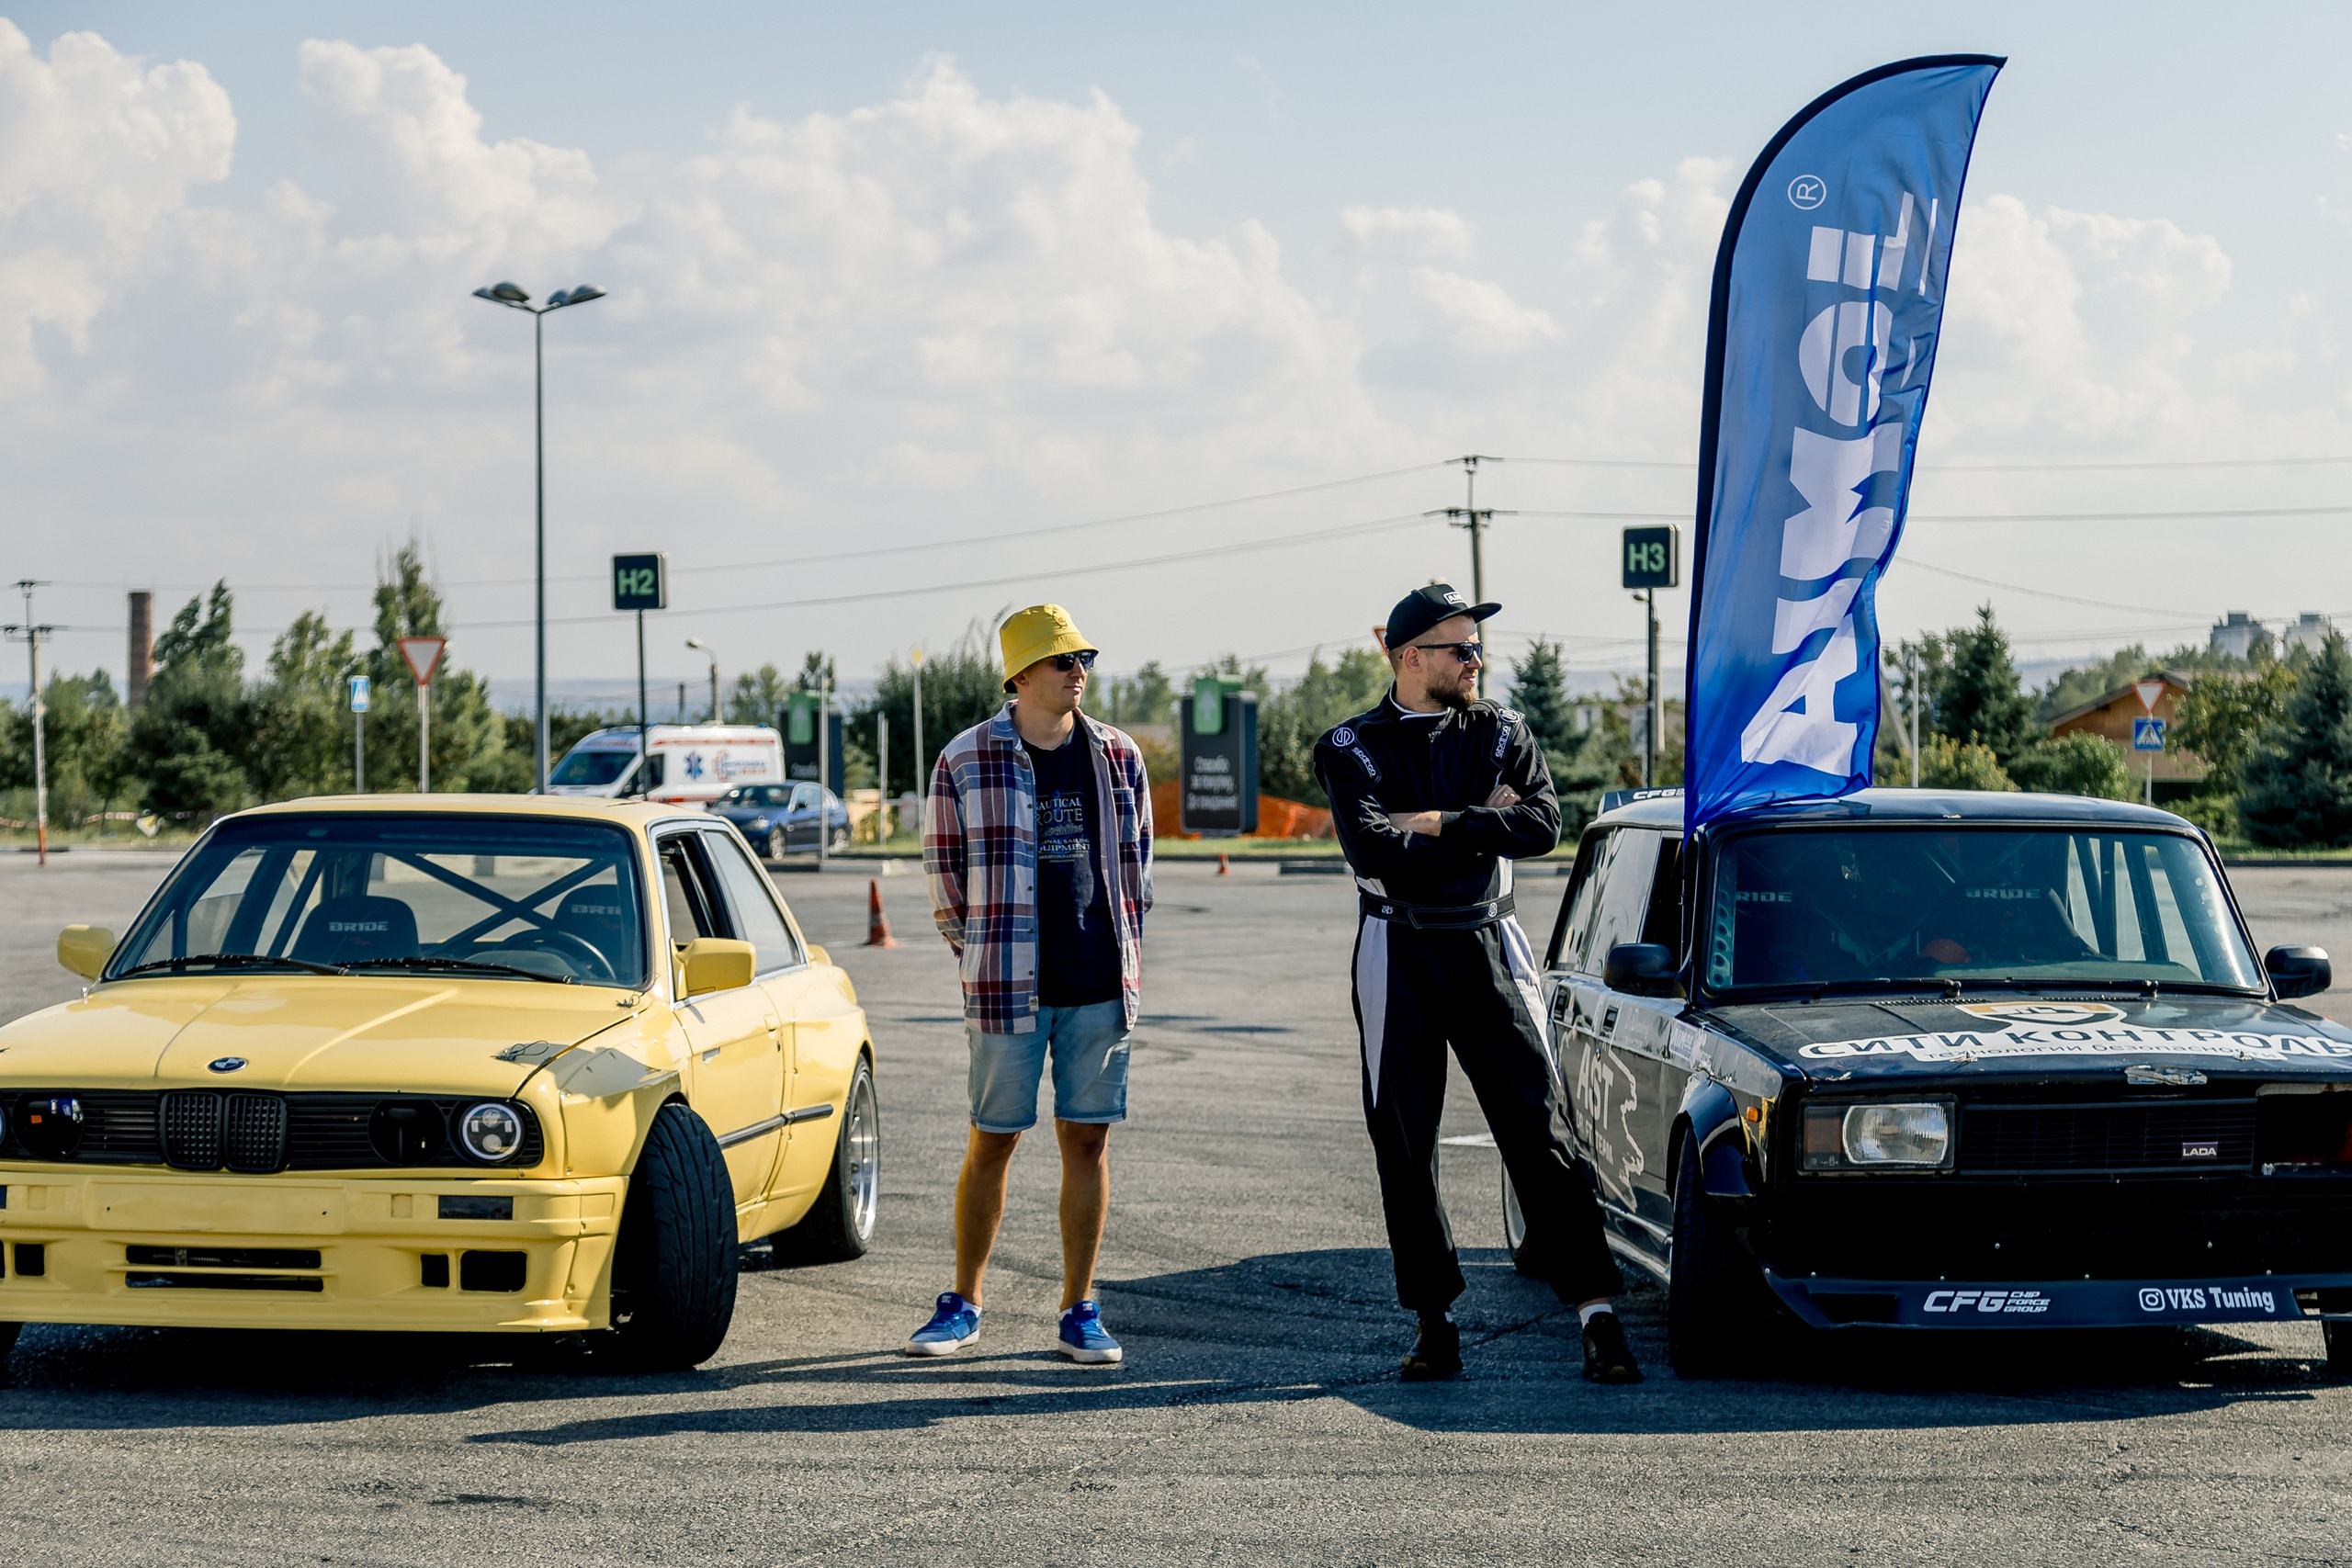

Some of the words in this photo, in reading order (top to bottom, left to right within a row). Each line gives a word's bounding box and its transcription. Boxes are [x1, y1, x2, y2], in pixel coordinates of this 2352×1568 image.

[1628, 543, 1666, 572] H3
[618, 569, 655, 596] H2
[1495, 726, 1511, 758] sparco
[1351, 746, 1376, 778] sparco
[1633, 789, 1676, 799] CFG
[1736, 891, 1793, 902] RIDE
[571, 904, 622, 915] BRI
[329, 921, 389, 932] BRIDE
[1809, 1033, 1984, 1055] СИТИ
[2006, 1030, 2352, 1055] КОНТРОЛЬ
[1923, 1044, 2082, 1058] технологии
[2092, 1043, 2277, 1058] безопасности
[1577, 1042, 1613, 1130] AST
[1576, 1108, 1594, 1146] DRFT
[1595, 1129, 1613, 1166] TEAM
[2183, 1147, 2217, 1156] LADA
[1923, 1291, 2008, 1313] CFG
[2165, 1288, 2206, 1310] VKS
[2209, 1286, 2276, 1313] Tuning
